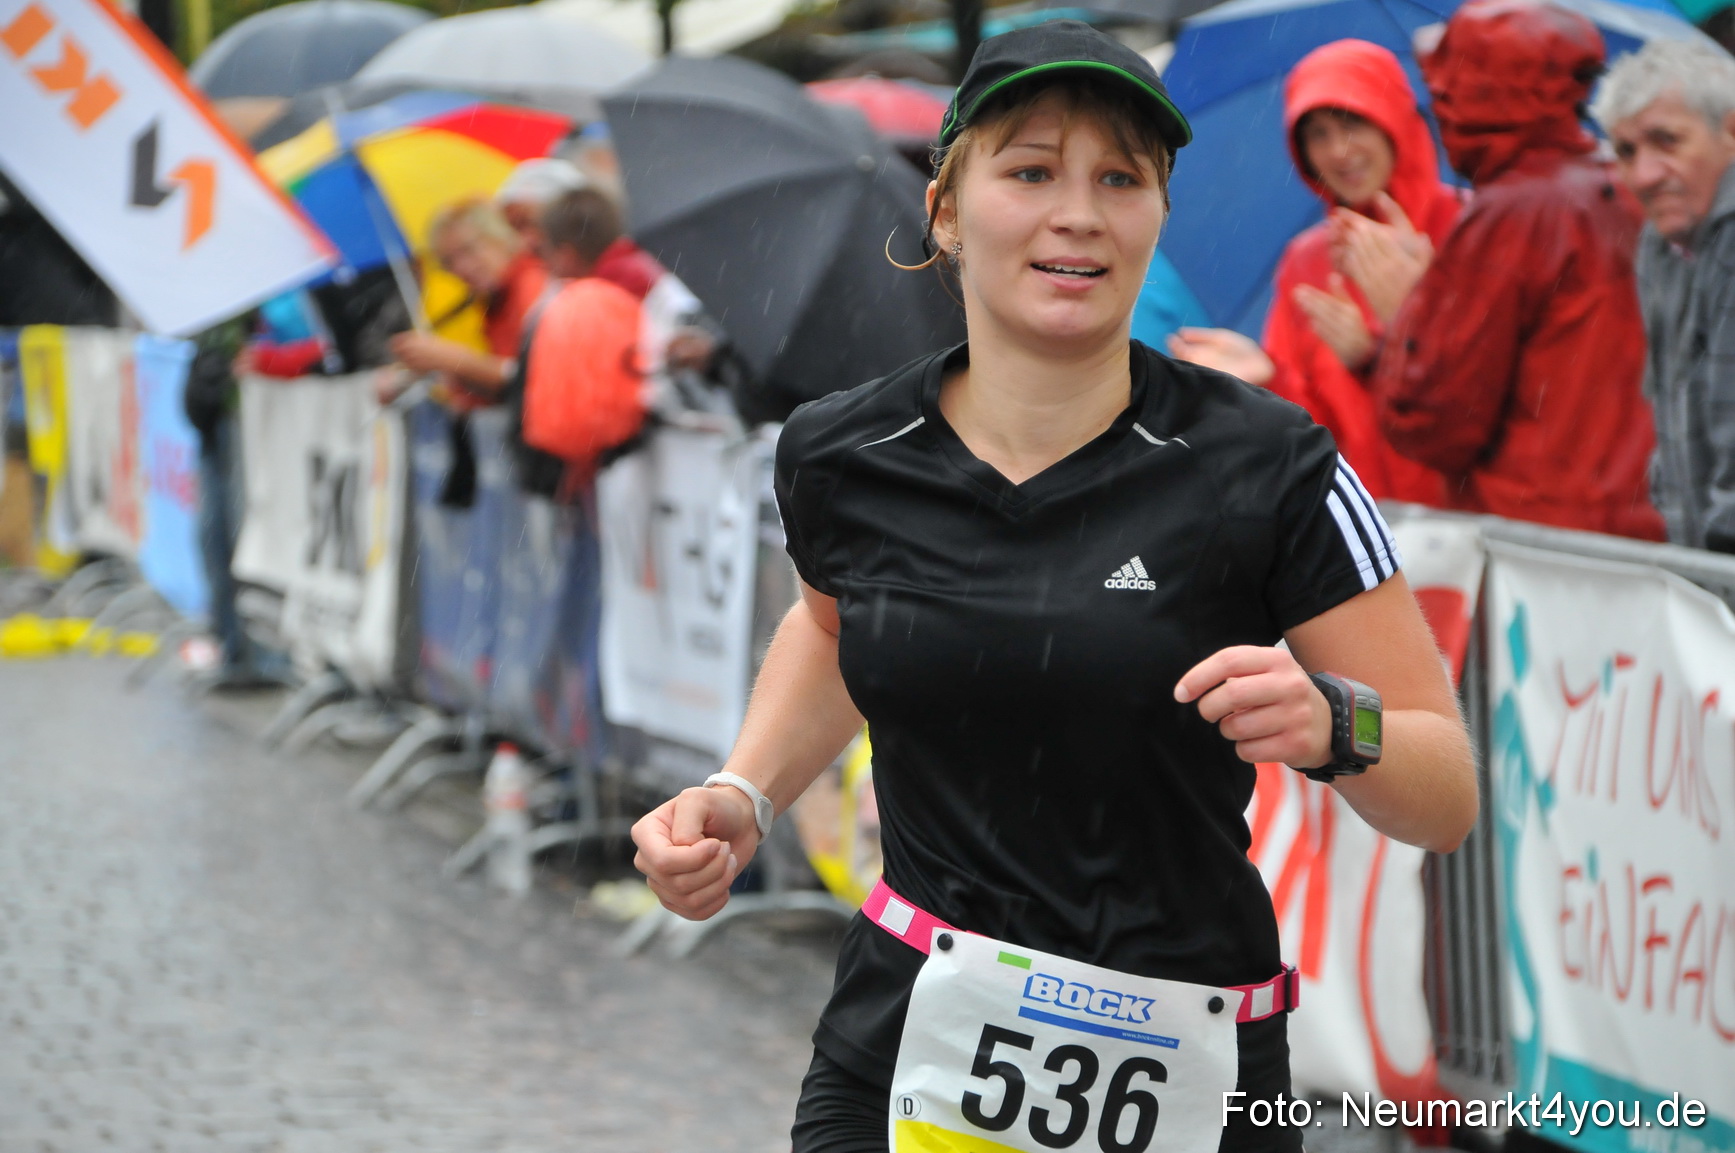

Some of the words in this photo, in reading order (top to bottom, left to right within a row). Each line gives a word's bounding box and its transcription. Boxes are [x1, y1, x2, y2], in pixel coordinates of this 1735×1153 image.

[1104, 576, 1156, 591] adidas
[1023, 973, 1156, 1023] BOCK
[961, 1023, 1168, 1153] 536
